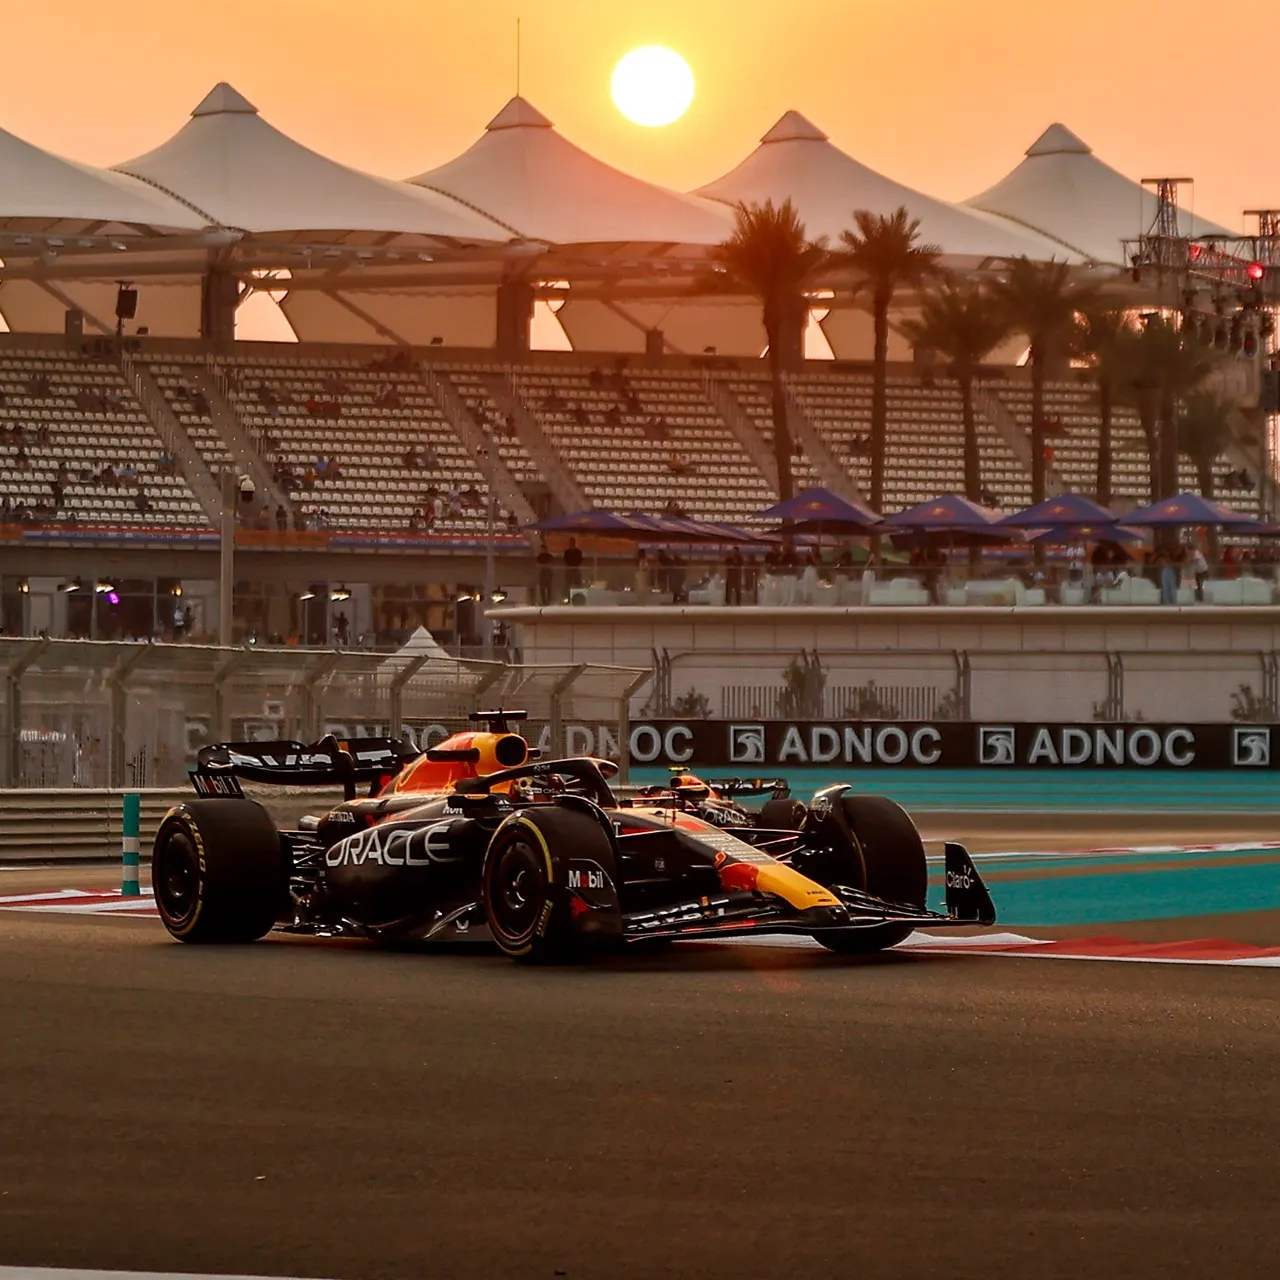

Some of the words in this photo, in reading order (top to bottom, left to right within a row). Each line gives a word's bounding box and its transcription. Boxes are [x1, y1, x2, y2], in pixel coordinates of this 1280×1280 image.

[778, 726, 942, 764] ADNOC
[1028, 728, 1196, 766] ADNOC
[193, 774, 229, 795] Mobil
[328, 811, 355, 823] HONDA
[325, 825, 464, 867] ORACLE
[568, 870, 604, 888] Mobil
[946, 871, 970, 889] Claro
